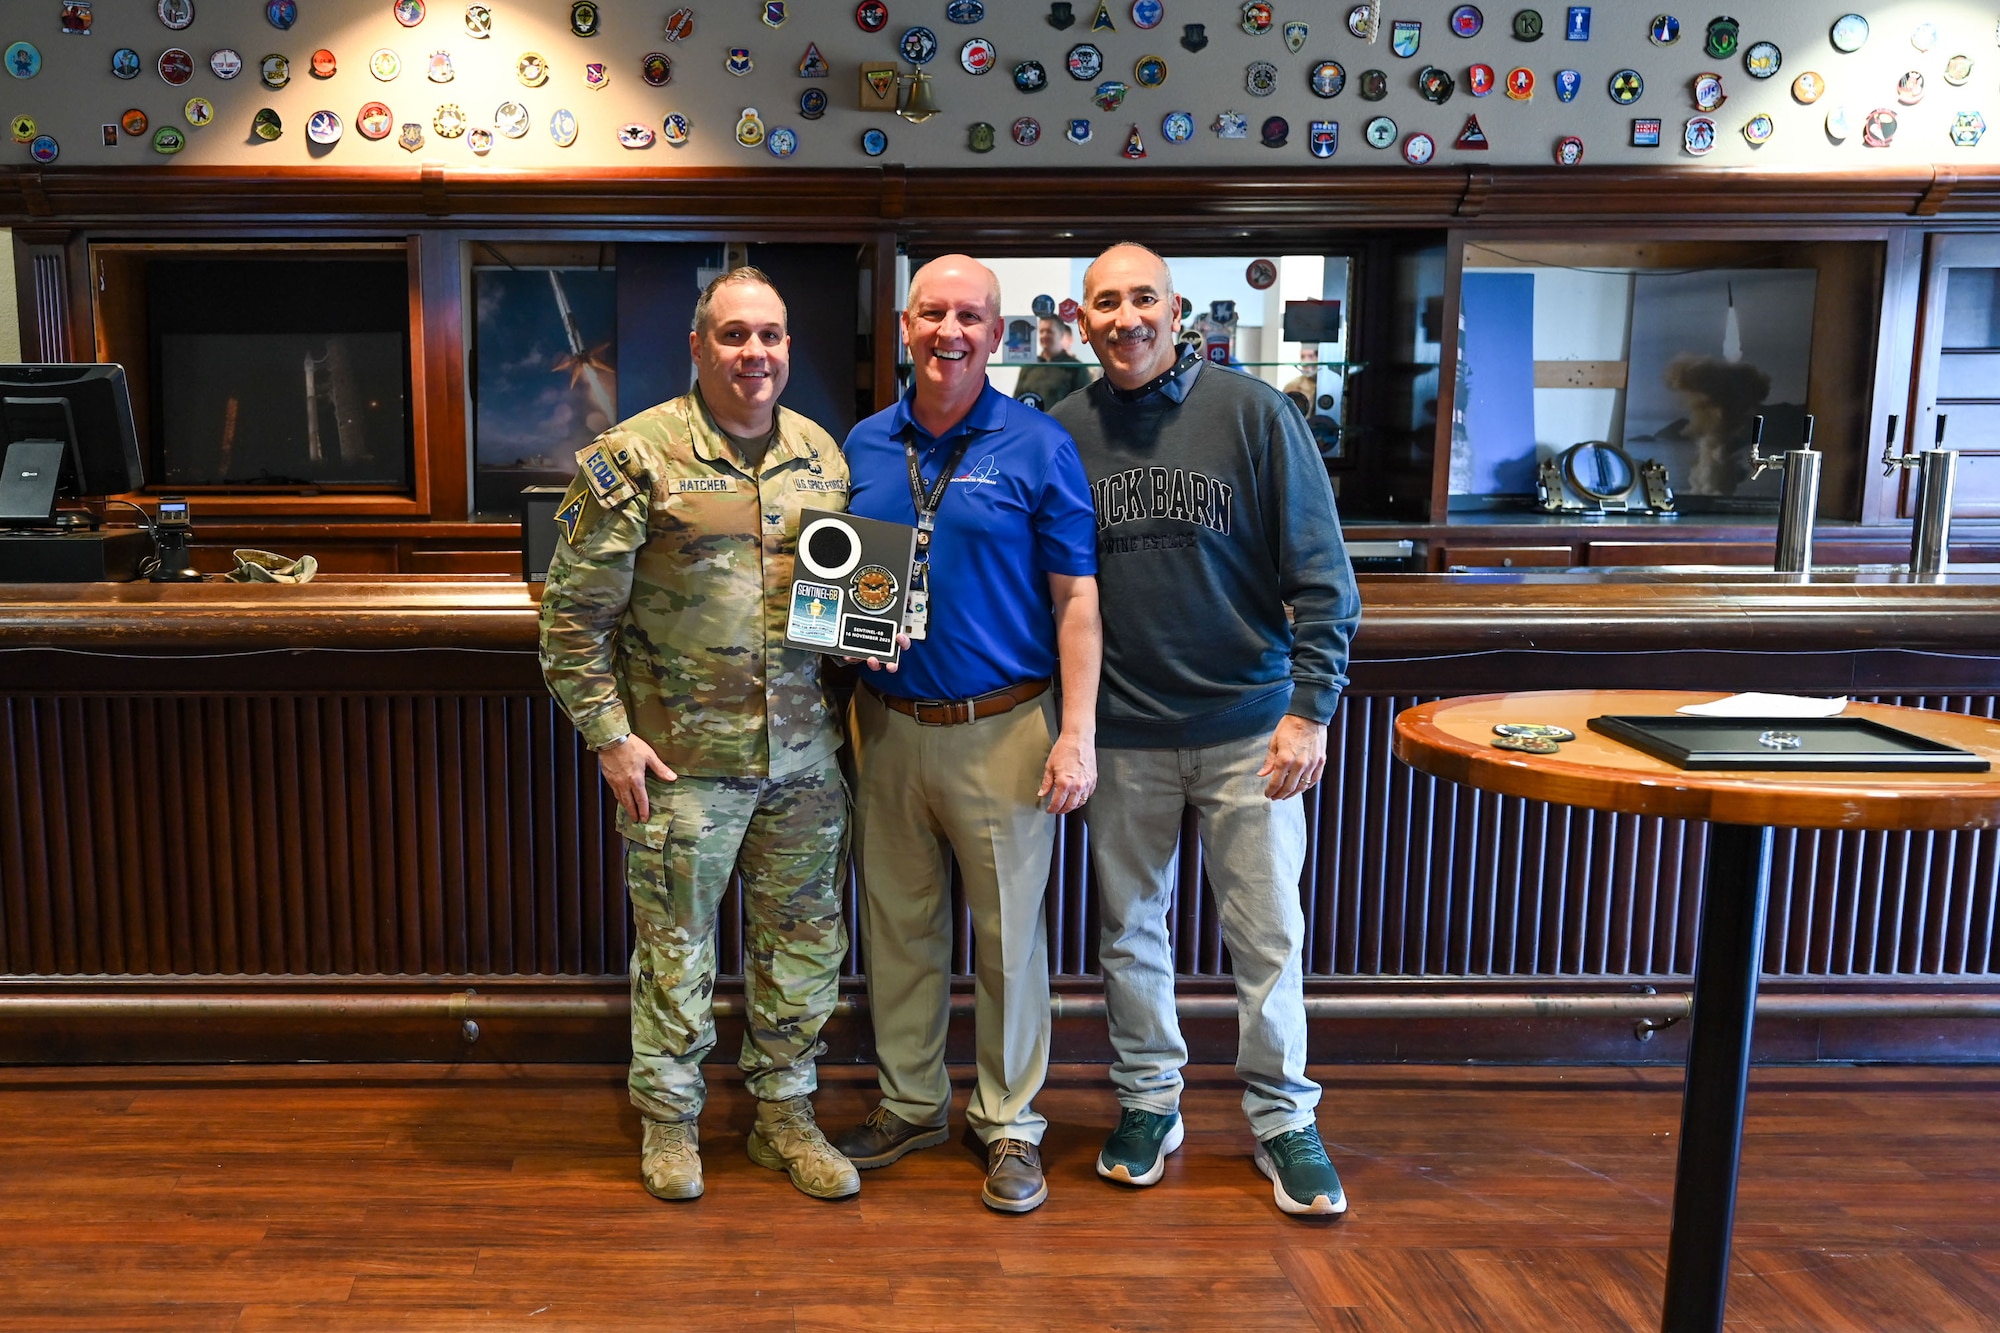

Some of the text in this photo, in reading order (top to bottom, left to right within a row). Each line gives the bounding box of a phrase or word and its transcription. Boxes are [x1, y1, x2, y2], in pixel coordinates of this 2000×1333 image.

[1521, 18, 1536, 34] K
[969, 50, 988, 62] easy
[586, 451, 616, 489] EOD
[679, 480, 727, 491] HATCHER
[795, 479, 846, 490] U.S. SPACE FORCE
[1149, 466, 1232, 536] BARN
[1103, 536, 1138, 554] WINE
[798, 584, 838, 600] SENTINEL-6B
[852, 633, 878, 641] NOVEMBER
[854, 627, 884, 636] SENTINEL-6B
